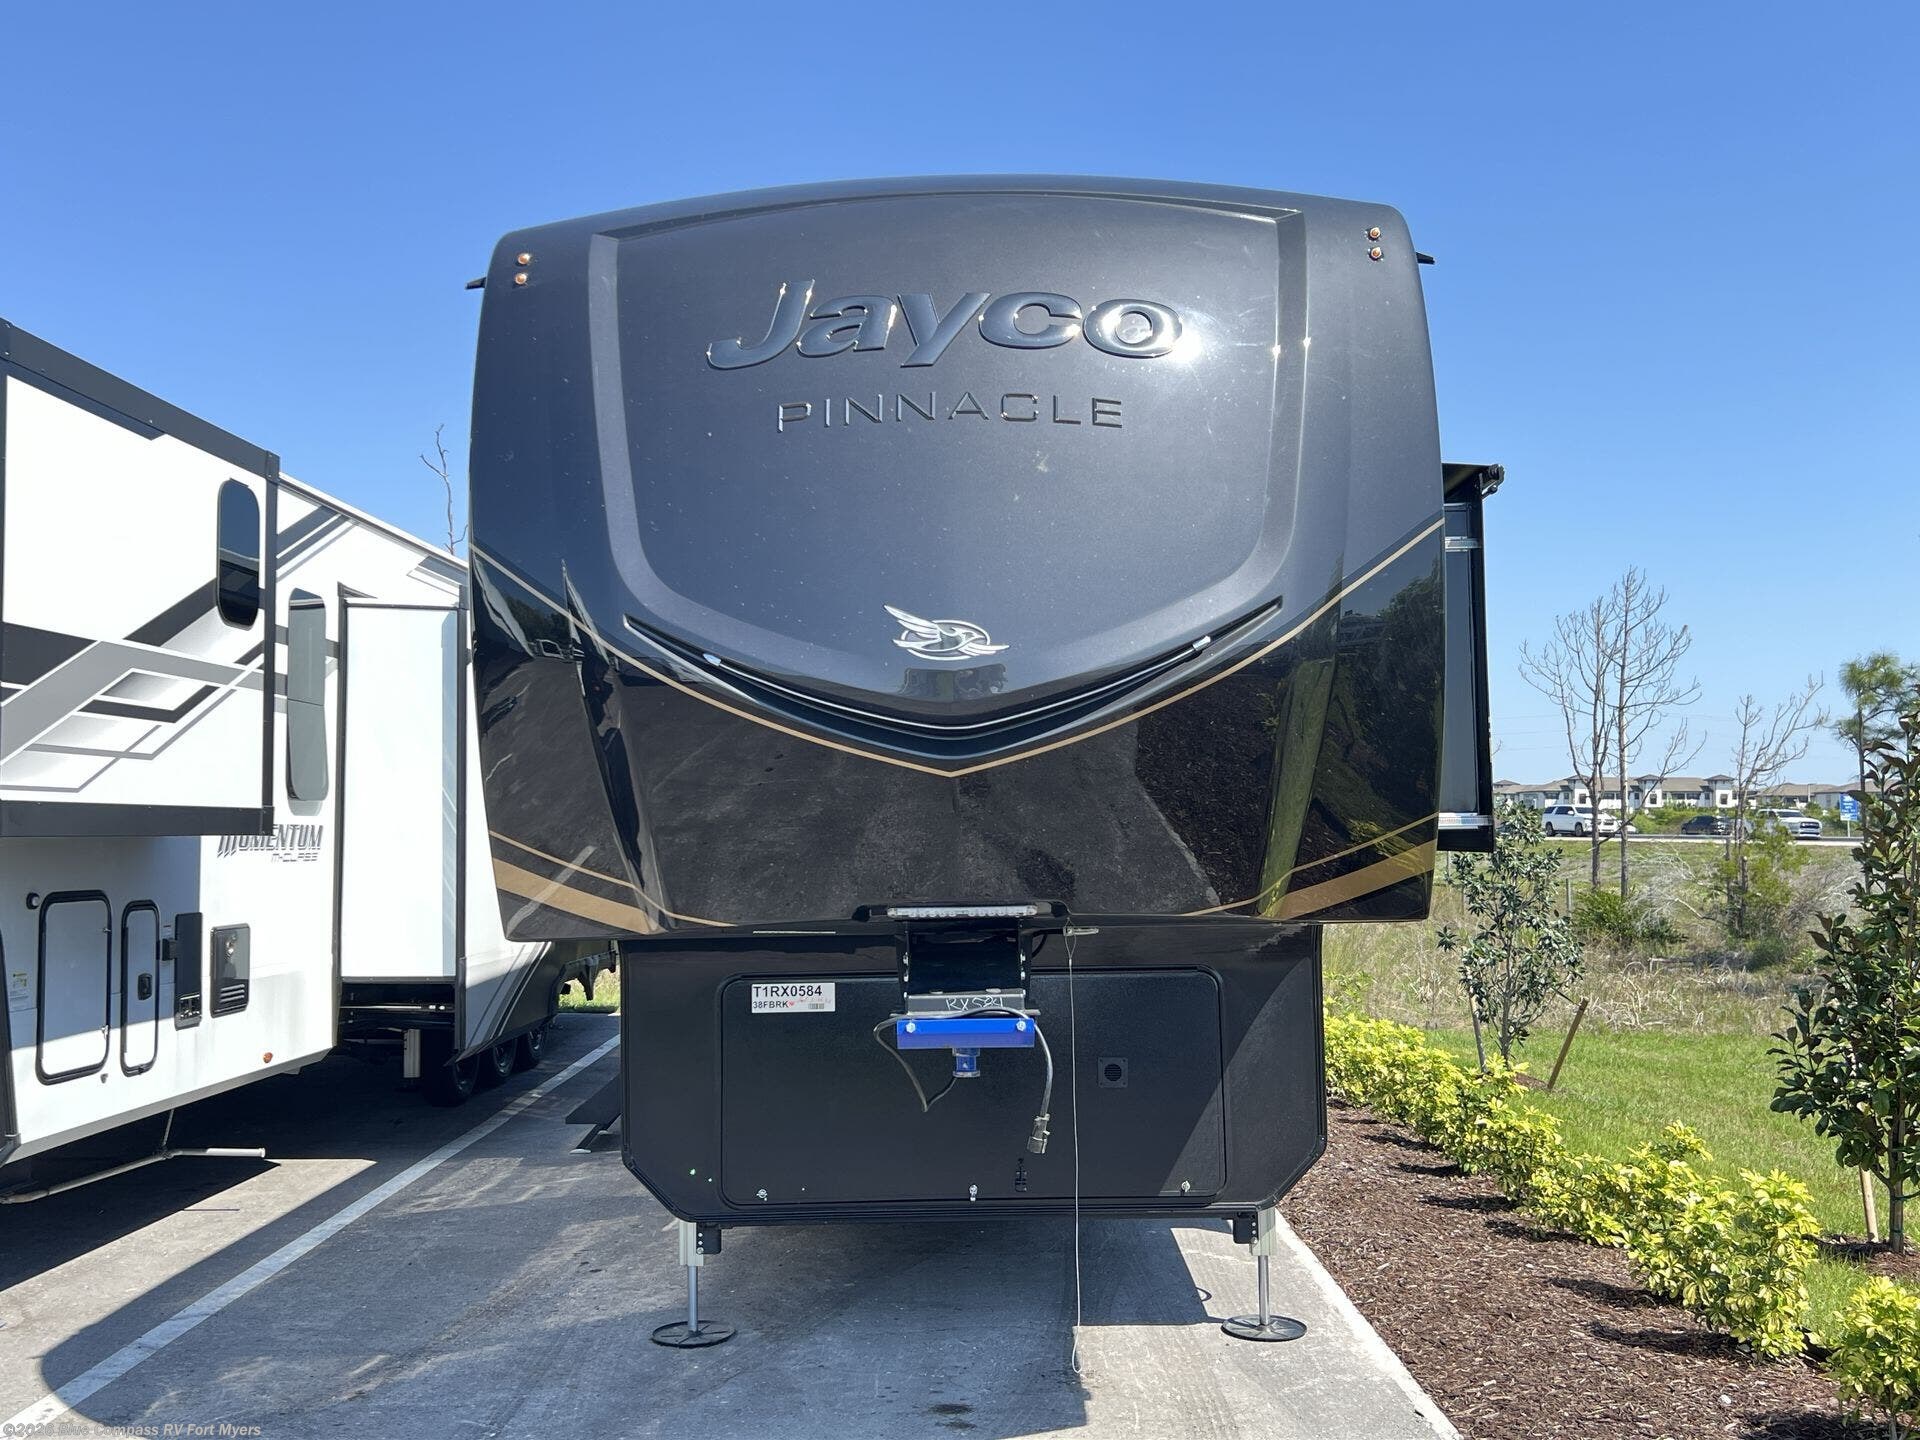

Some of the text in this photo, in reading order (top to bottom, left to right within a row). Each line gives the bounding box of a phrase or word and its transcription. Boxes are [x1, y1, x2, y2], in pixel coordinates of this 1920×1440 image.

[706, 279, 1184, 370] Jayco
[777, 391, 1123, 433] PINNACLE
[753, 985, 823, 997] T1RX0584
[753, 1000, 789, 1009] 38FBRK
